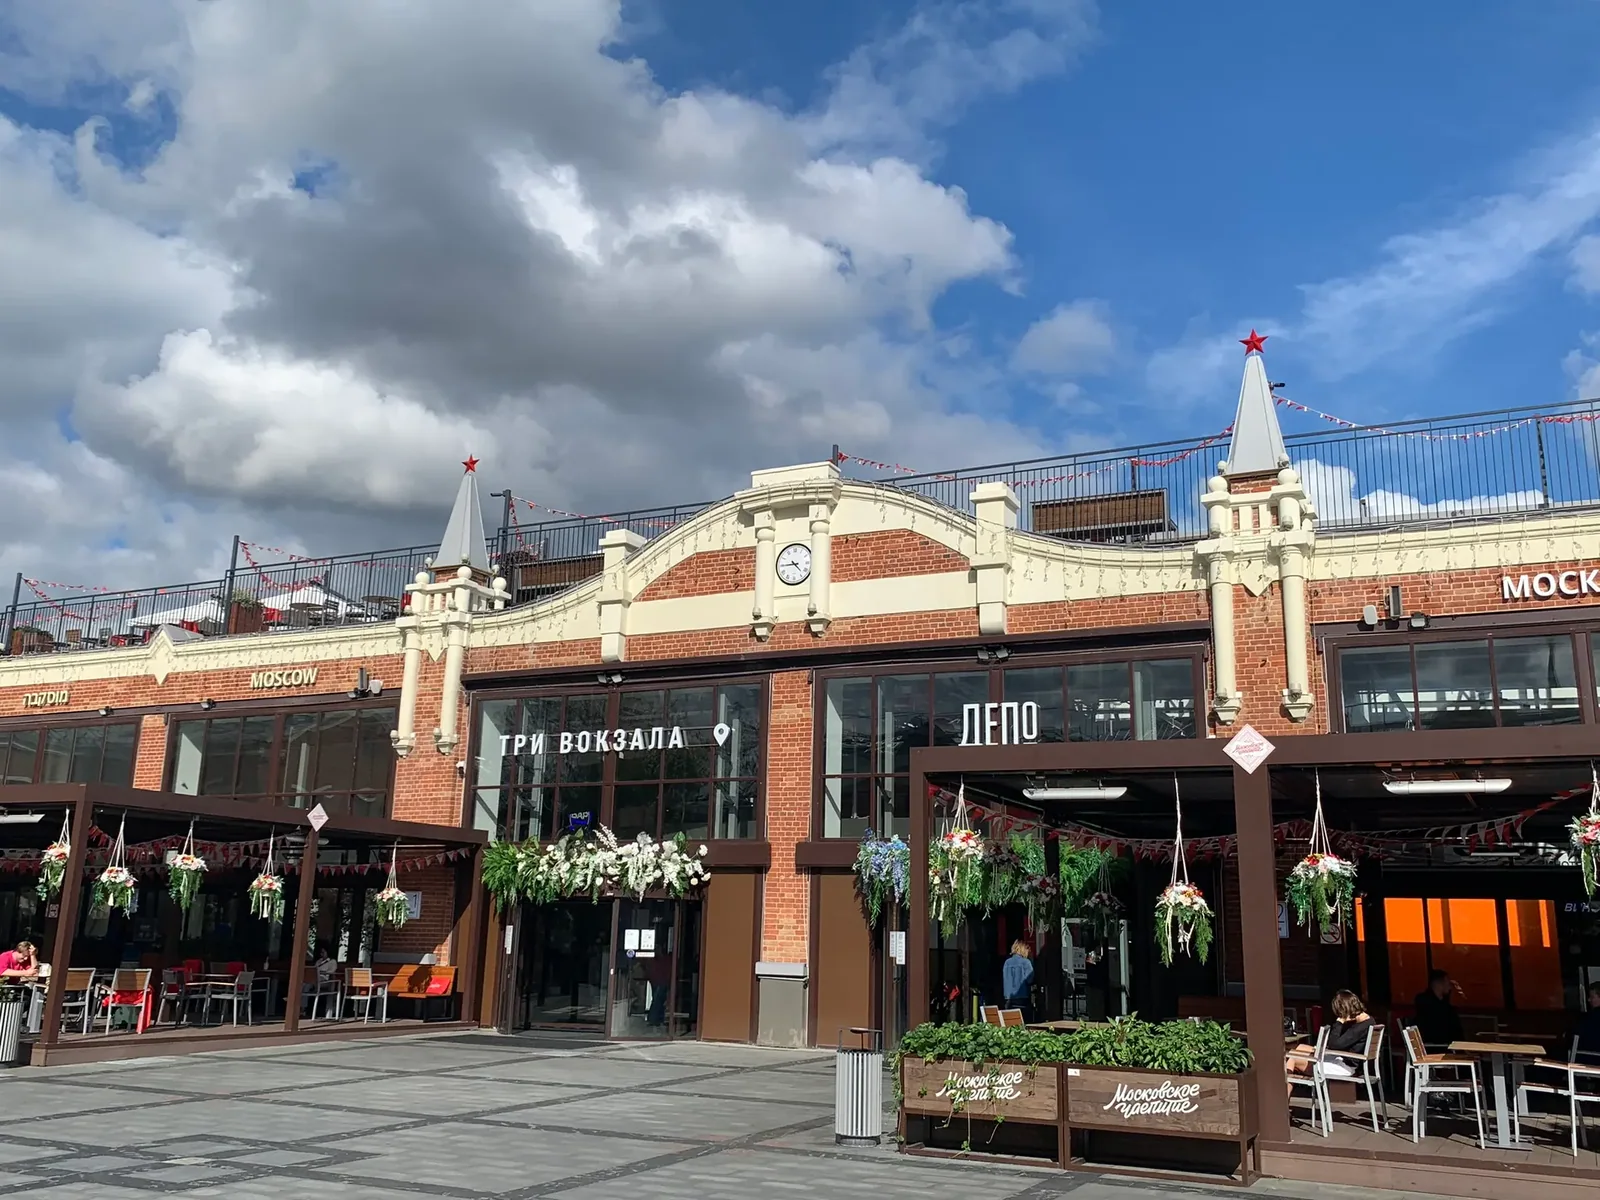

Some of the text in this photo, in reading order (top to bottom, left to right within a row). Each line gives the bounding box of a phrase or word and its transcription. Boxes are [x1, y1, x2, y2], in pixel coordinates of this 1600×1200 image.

[1502, 569, 1600, 599] МОСК
[250, 667, 319, 689] MOSCOW
[22, 690, 69, 708] מוסקבה
[958, 701, 1039, 747] ДЕПО
[499, 726, 685, 757] ТРИ ВОКЗАЛА
[1102, 1080, 1200, 1110] Московское
[1114, 1097, 1199, 1119] чаепитие
